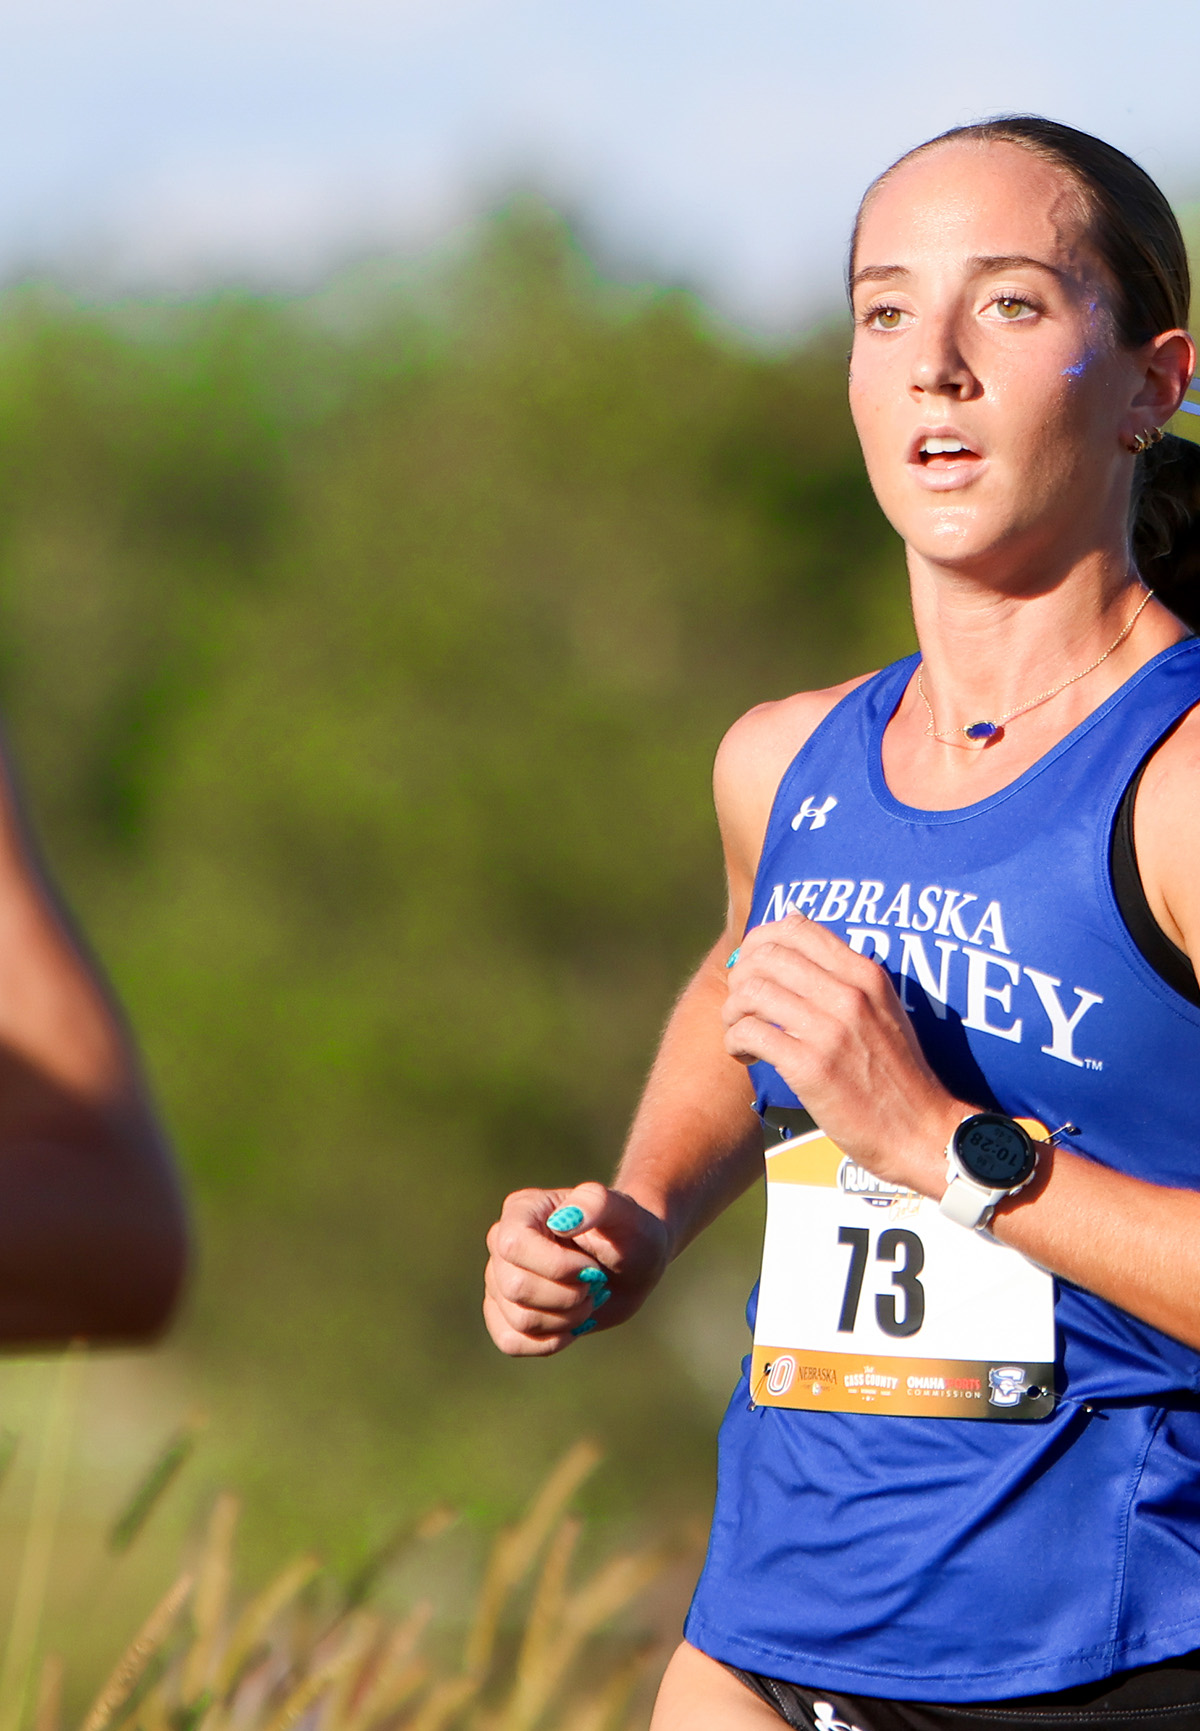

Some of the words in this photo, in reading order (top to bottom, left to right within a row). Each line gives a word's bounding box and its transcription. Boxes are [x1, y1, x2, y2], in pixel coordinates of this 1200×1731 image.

[762, 880, 1011, 955] NEBRASKA
[970, 1132, 1018, 1167] 10:28
[836, 1226, 926, 1338] 73
[798, 1366, 838, 1385] NEBRASKA
[844, 1374, 864, 1387] CASS
[864, 1373, 898, 1390] COUNTY
[906, 1388, 982, 1399] COMMISSION
